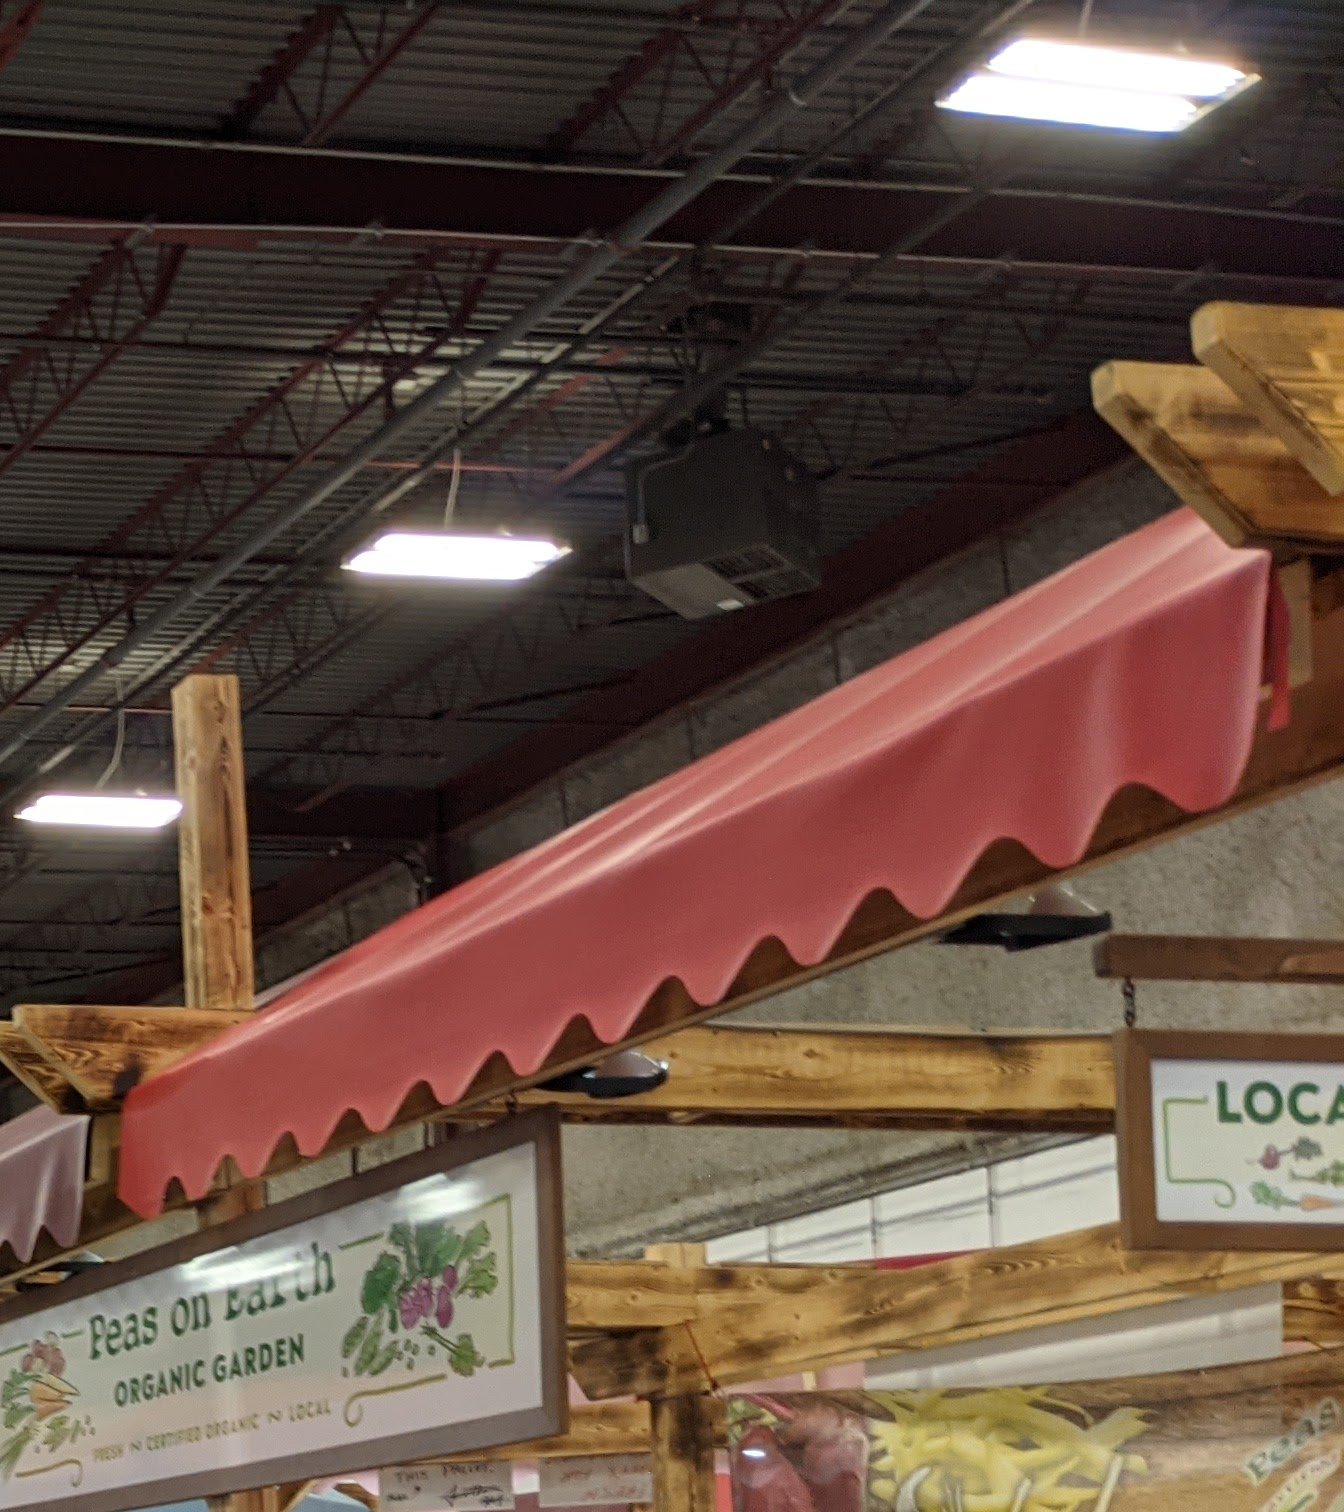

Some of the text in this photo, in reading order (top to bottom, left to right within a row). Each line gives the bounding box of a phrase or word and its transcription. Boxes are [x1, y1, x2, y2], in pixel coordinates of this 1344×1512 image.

[89, 1306, 159, 1360] Peas
[170, 1291, 212, 1337] on
[114, 1332, 304, 1407] ORGANIC GARDEN
[206, 1413, 260, 1441] ORGANIC
[288, 1401, 332, 1423] LOCAL
